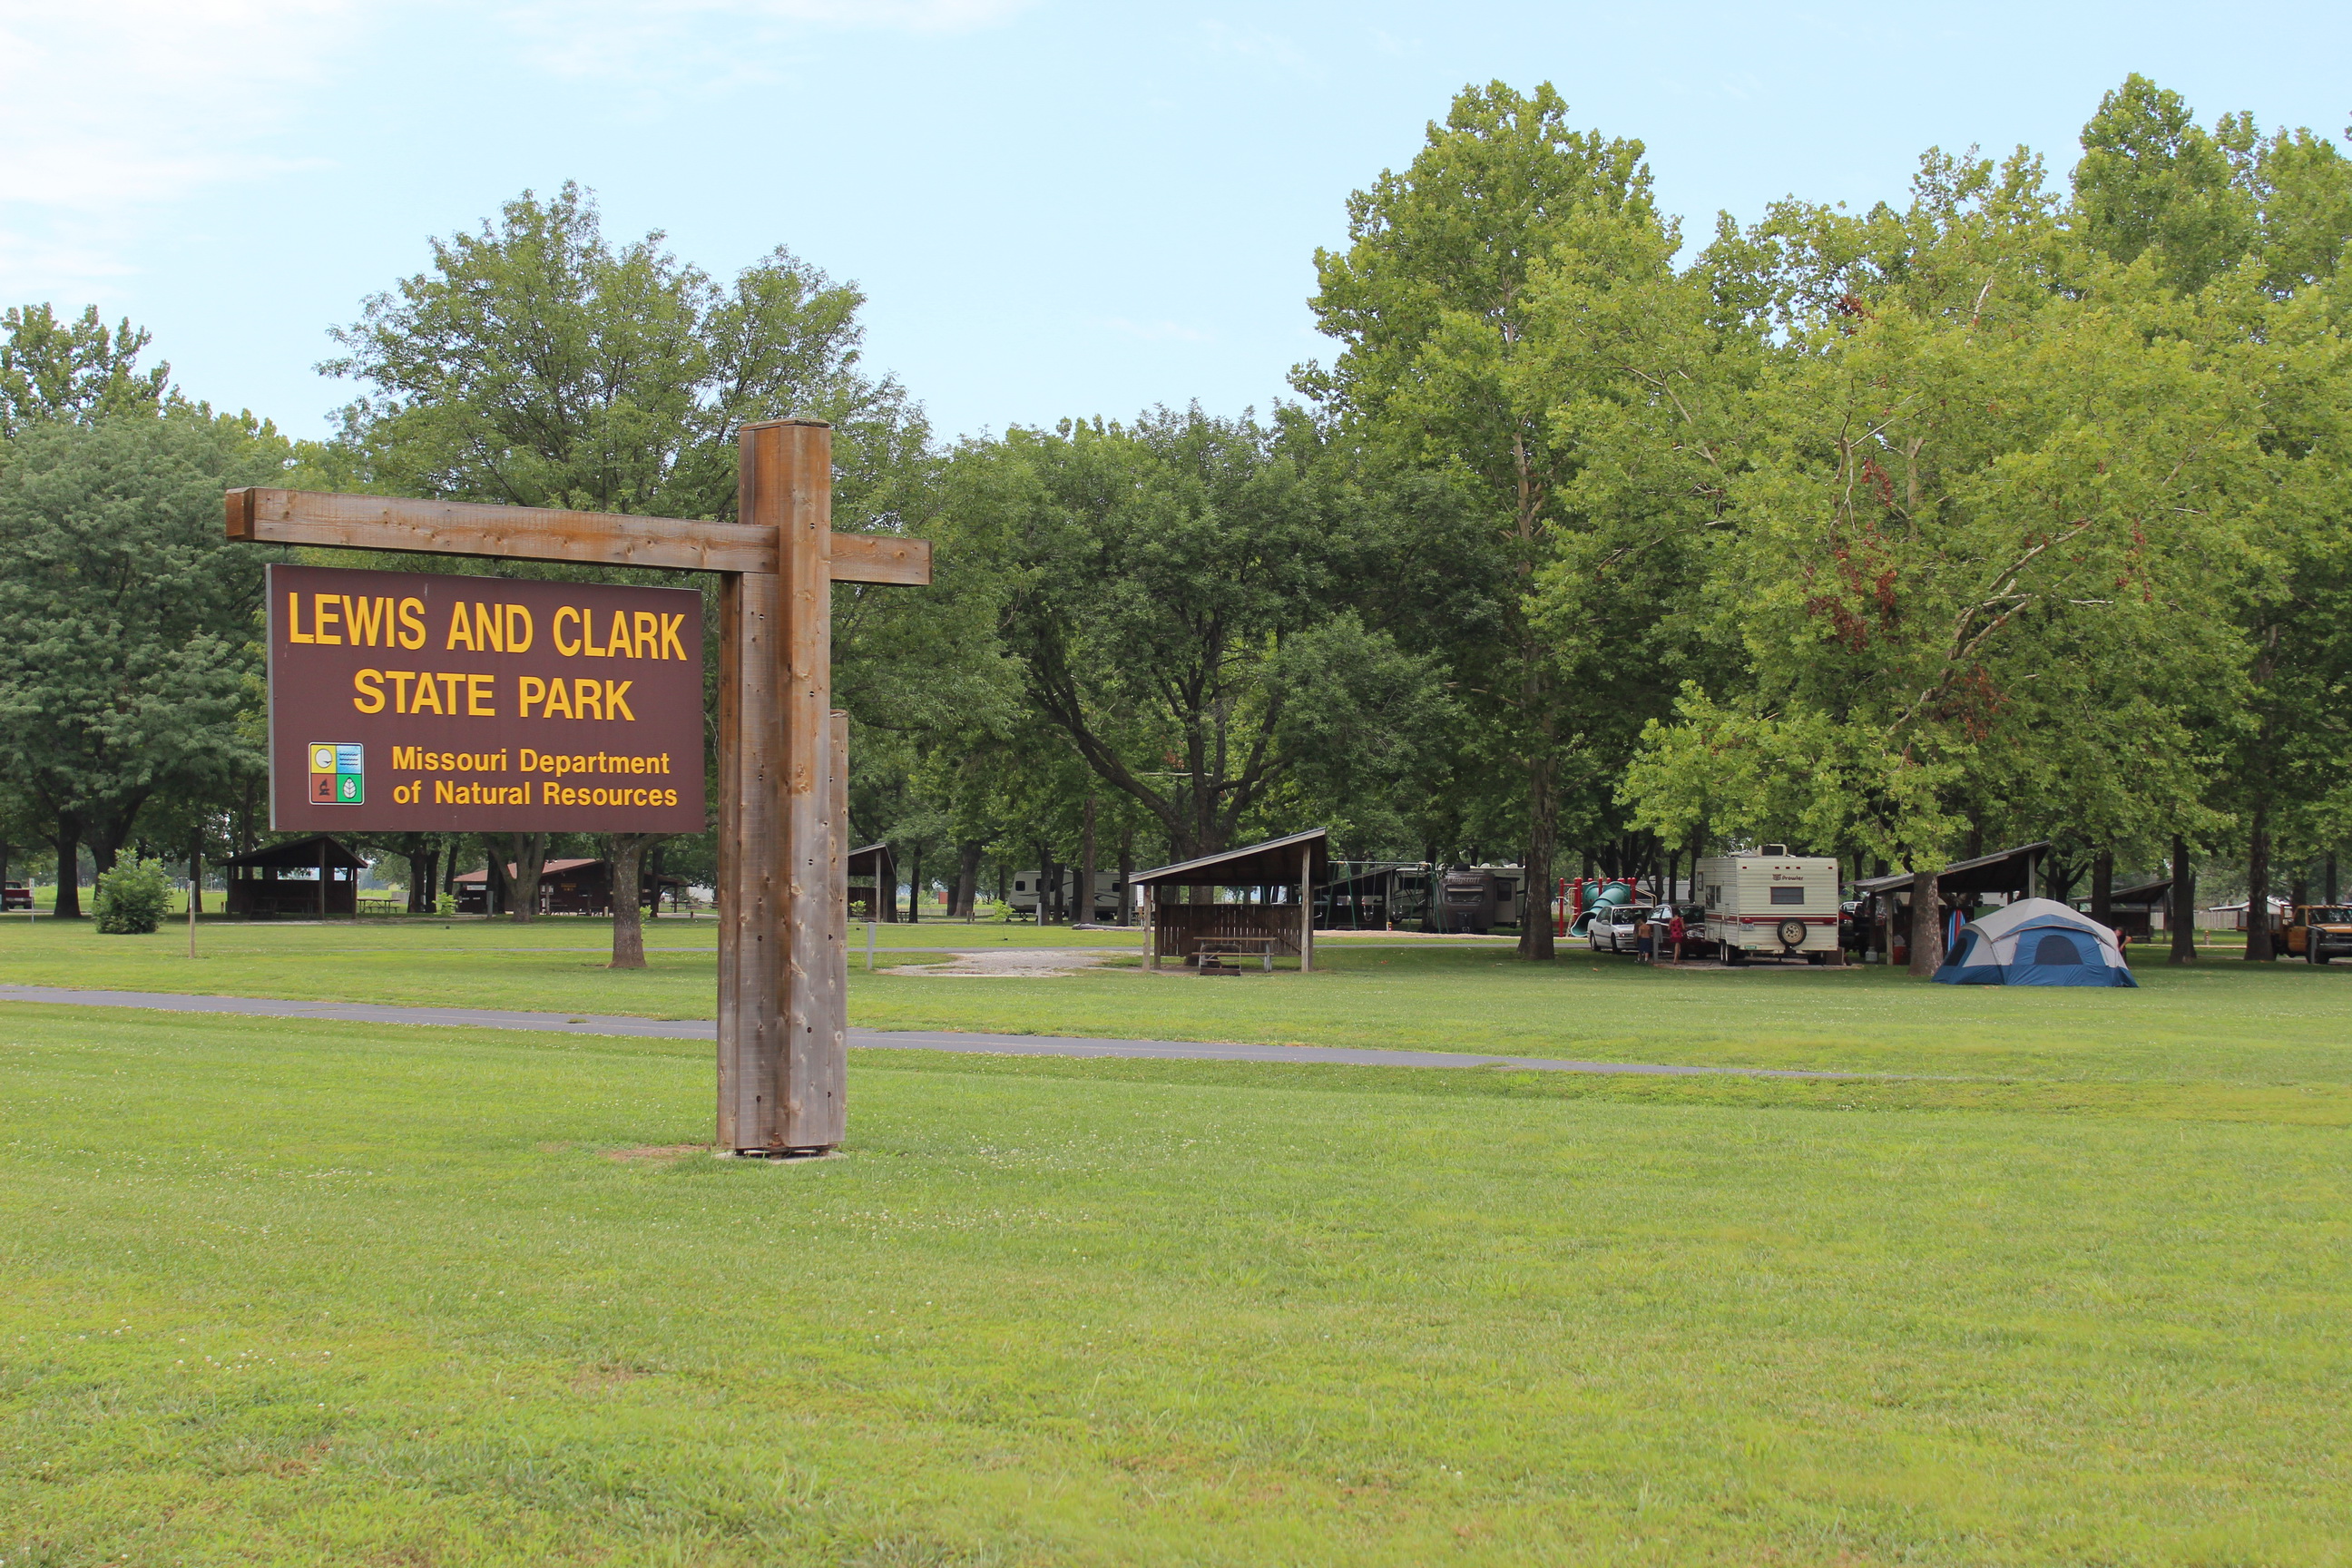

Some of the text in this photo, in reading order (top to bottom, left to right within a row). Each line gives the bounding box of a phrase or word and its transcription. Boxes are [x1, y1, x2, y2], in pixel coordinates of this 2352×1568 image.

[289, 592, 688, 661] LEWIS AND CLARK
[352, 668, 636, 721] STATE PARK
[391, 745, 671, 778] Missouri Department
[392, 779, 678, 807] of Natural Resources
